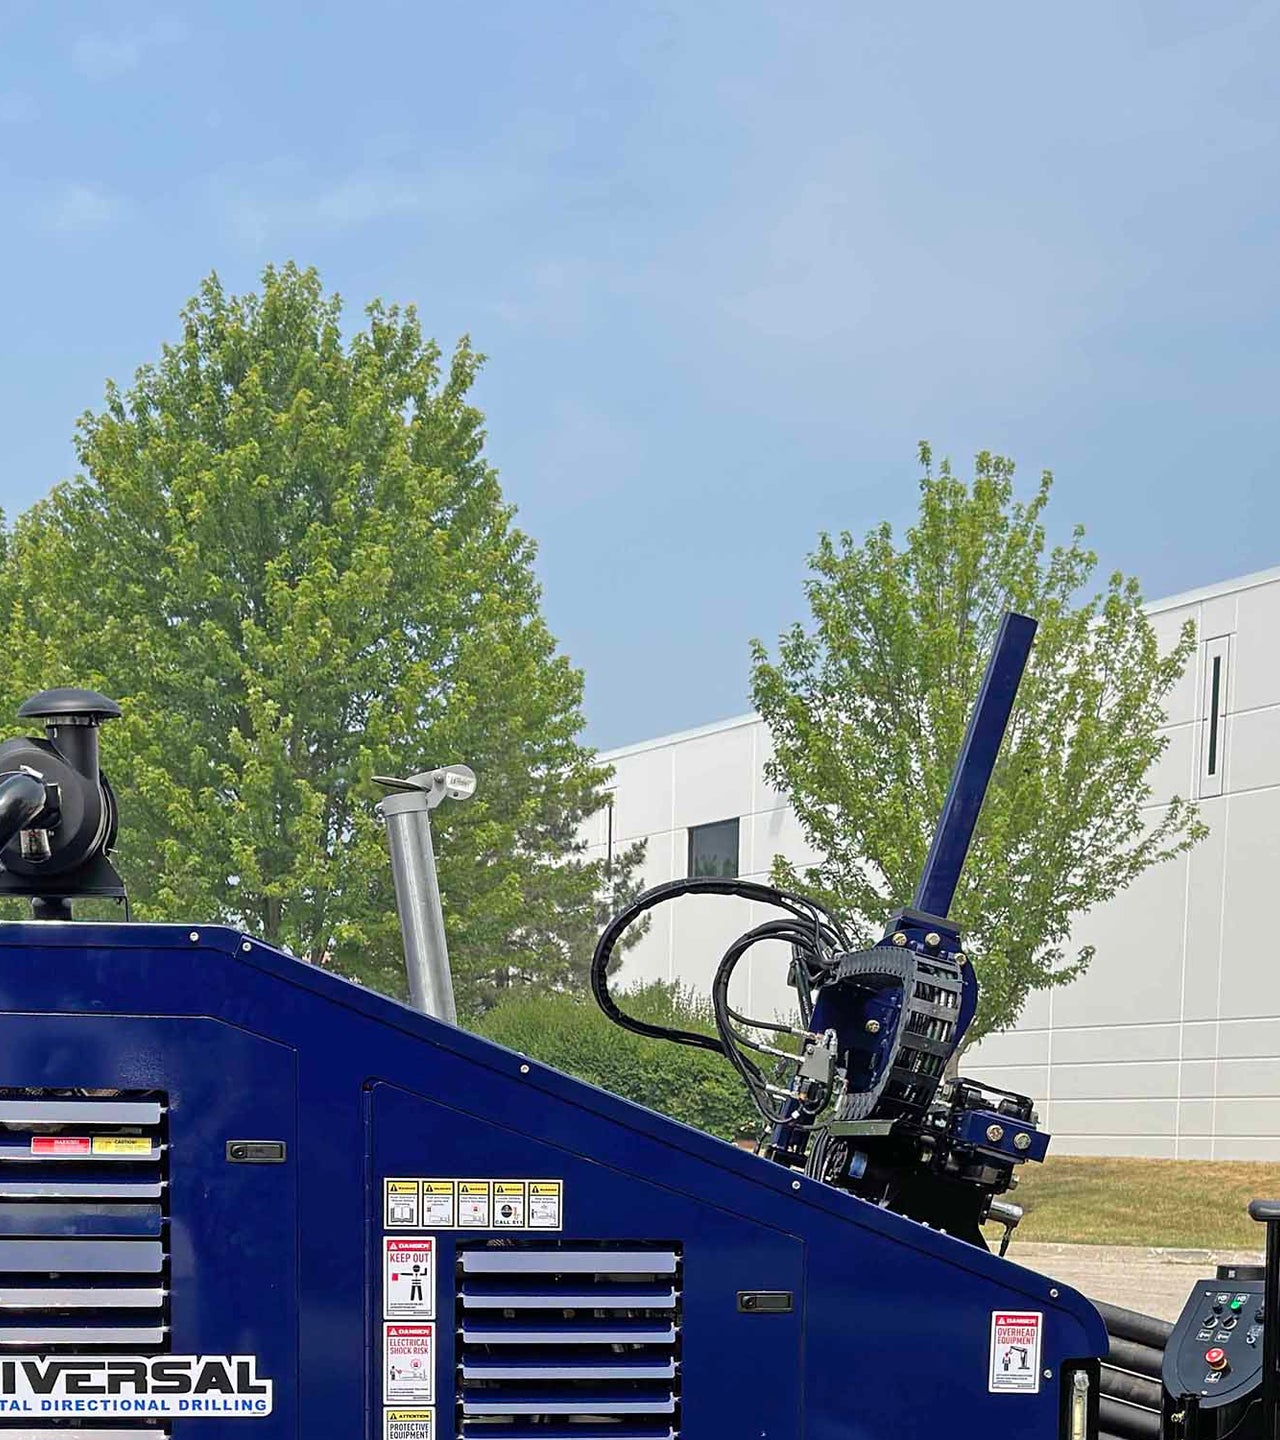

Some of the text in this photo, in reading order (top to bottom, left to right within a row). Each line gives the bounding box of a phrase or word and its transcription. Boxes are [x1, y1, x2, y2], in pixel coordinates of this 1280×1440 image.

[389, 1252, 429, 1263] KEEP OUT
[997, 1327, 1036, 1337] OVERHEAD
[389, 1338, 429, 1347] ELECTRICAL
[997, 1336, 1035, 1345] EQUIPMENT
[389, 1346, 429, 1355] SHOCK RISK
[41, 1399, 171, 1411] DIRECTIONAL
[178, 1399, 267, 1411] DRILLING
[389, 1423, 429, 1432] PROTECTIVE
[389, 1431, 429, 1440] EQUIPMENT
